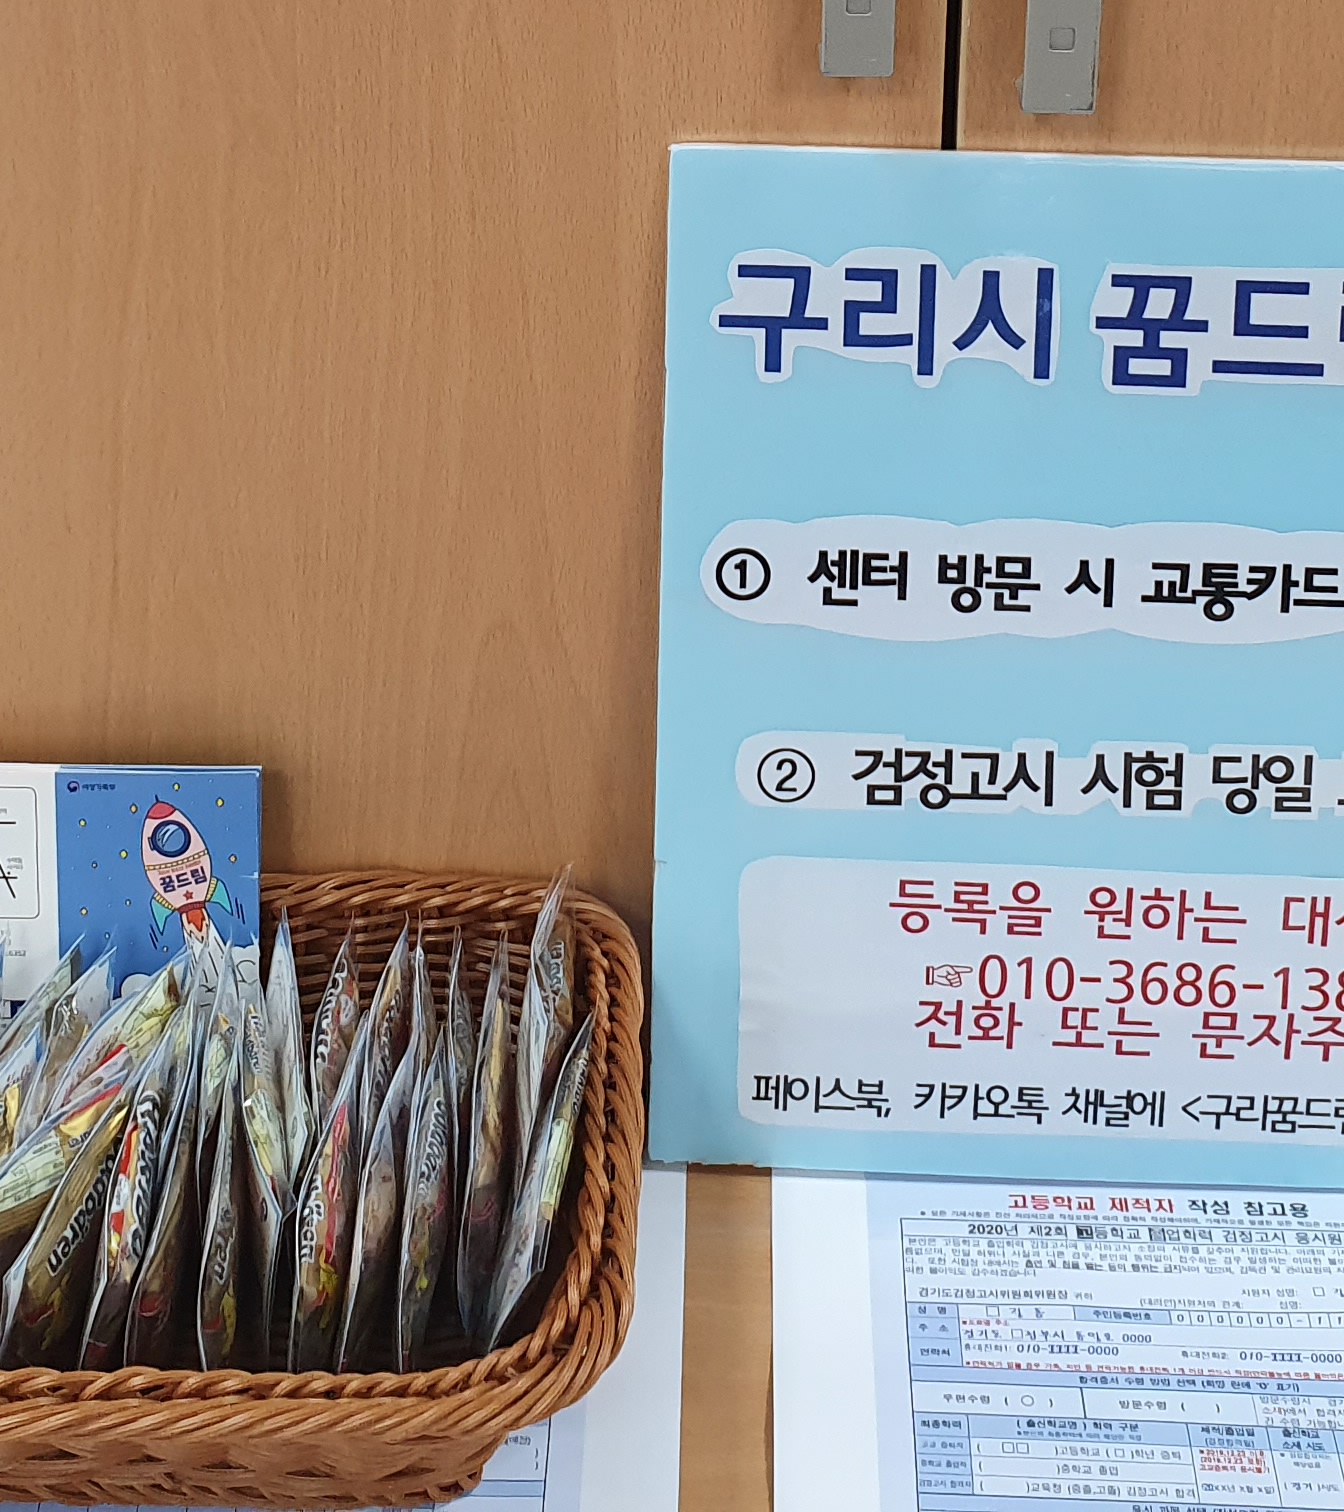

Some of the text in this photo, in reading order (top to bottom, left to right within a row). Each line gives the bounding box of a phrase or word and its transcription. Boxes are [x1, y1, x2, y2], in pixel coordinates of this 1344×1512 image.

[716, 261, 1056, 381] 구리시
[806, 548, 909, 607] 센터
[937, 554, 1040, 612] 방문
[1064, 558, 1116, 608] 시
[850, 747, 1055, 810] 검정고시
[1081, 751, 1185, 815] 시험
[1210, 755, 1315, 816] 당일
[159, 865, 208, 893] 꿈드림
[888, 879, 1052, 934] 등록을
[1083, 887, 1248, 945] 원하는
[913, 997, 1023, 1052] 전화
[1050, 1004, 1161, 1058] 또는
[751, 1075, 891, 1120] 페이스북,
[913, 1081, 1050, 1125] 카카오톡
[1062, 1085, 1166, 1129] 채널에
[1008, 1194, 1310, 1218] 고등학교 제적자 작성 참고용
[967, 1223, 1018, 1237] 2020년
[1027, 1225, 1069, 1237] 제2회
[1076, 1224, 1141, 1239] 고등학교
[1222, 1229, 1286, 1244] 검정고시
[1122, 1333, 1152, 1343] 0000
[943, 1393, 1167, 1411] 우편수령 방문수령
[1118, 1422, 1139, 1432] 구분
